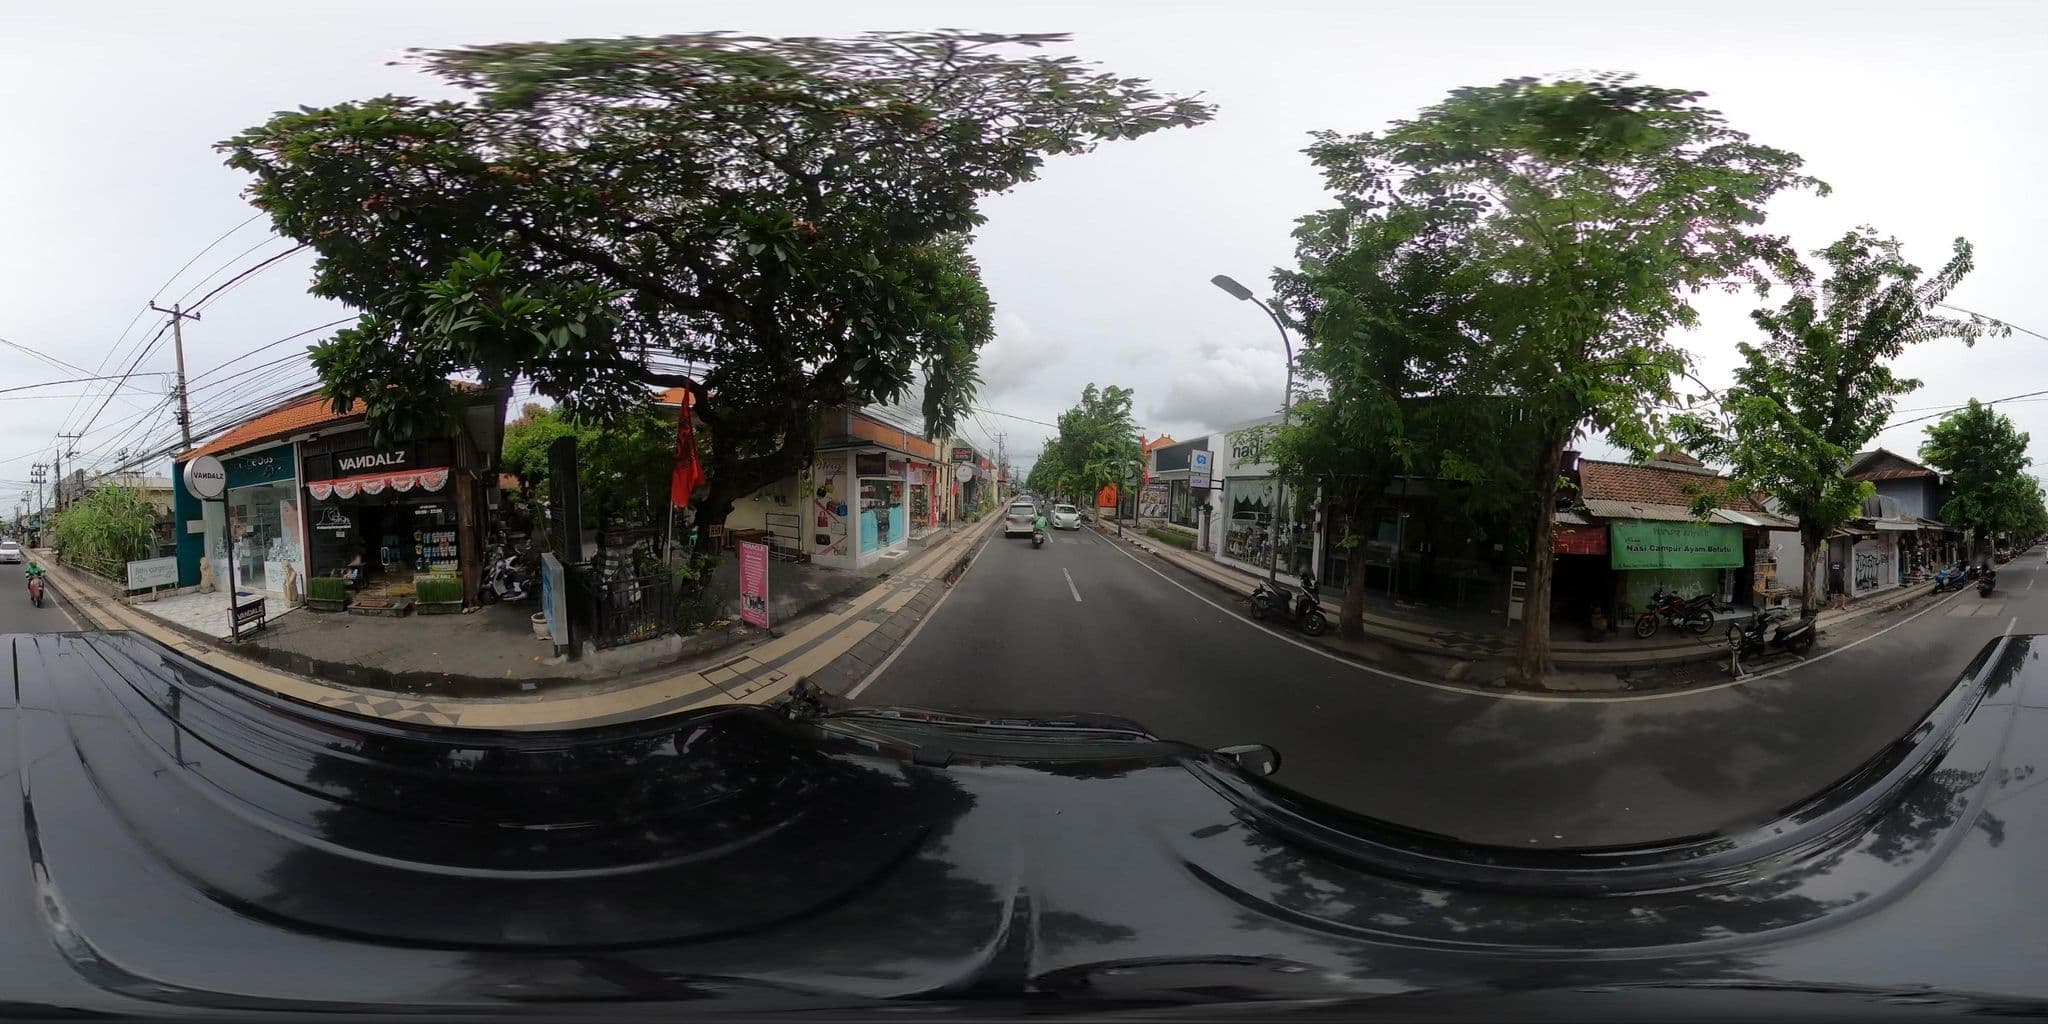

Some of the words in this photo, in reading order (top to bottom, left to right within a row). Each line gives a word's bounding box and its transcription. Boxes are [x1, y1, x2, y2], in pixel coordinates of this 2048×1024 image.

[338, 451, 406, 471] VANDALZ
[193, 472, 224, 480] VANDALZ
[1626, 544, 1647, 552] Nasi
[1649, 544, 1681, 553] Campur
[1683, 545, 1706, 554] Ayam
